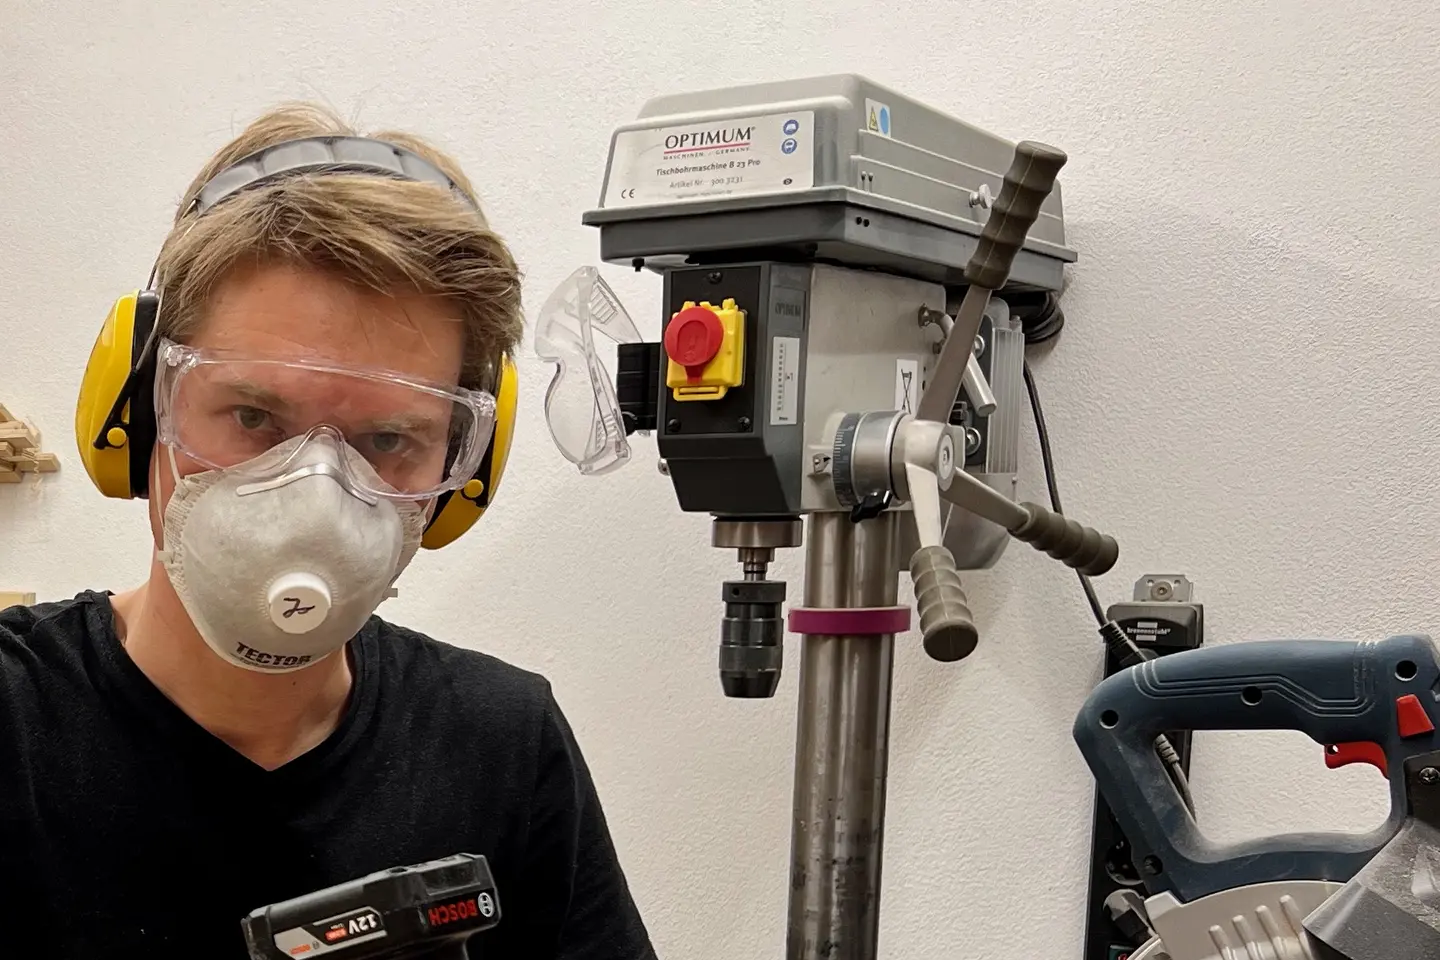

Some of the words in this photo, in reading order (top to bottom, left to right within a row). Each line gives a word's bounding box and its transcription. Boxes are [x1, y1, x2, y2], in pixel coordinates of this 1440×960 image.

[715, 147, 750, 155] GERMANY
[656, 162, 727, 176] Tischbohrmaschine
[736, 161, 746, 169] 23
[747, 159, 761, 167] Pro
[236, 641, 312, 666] TECTOR
[428, 899, 478, 925] BOSCH
[348, 914, 378, 935] 12V
